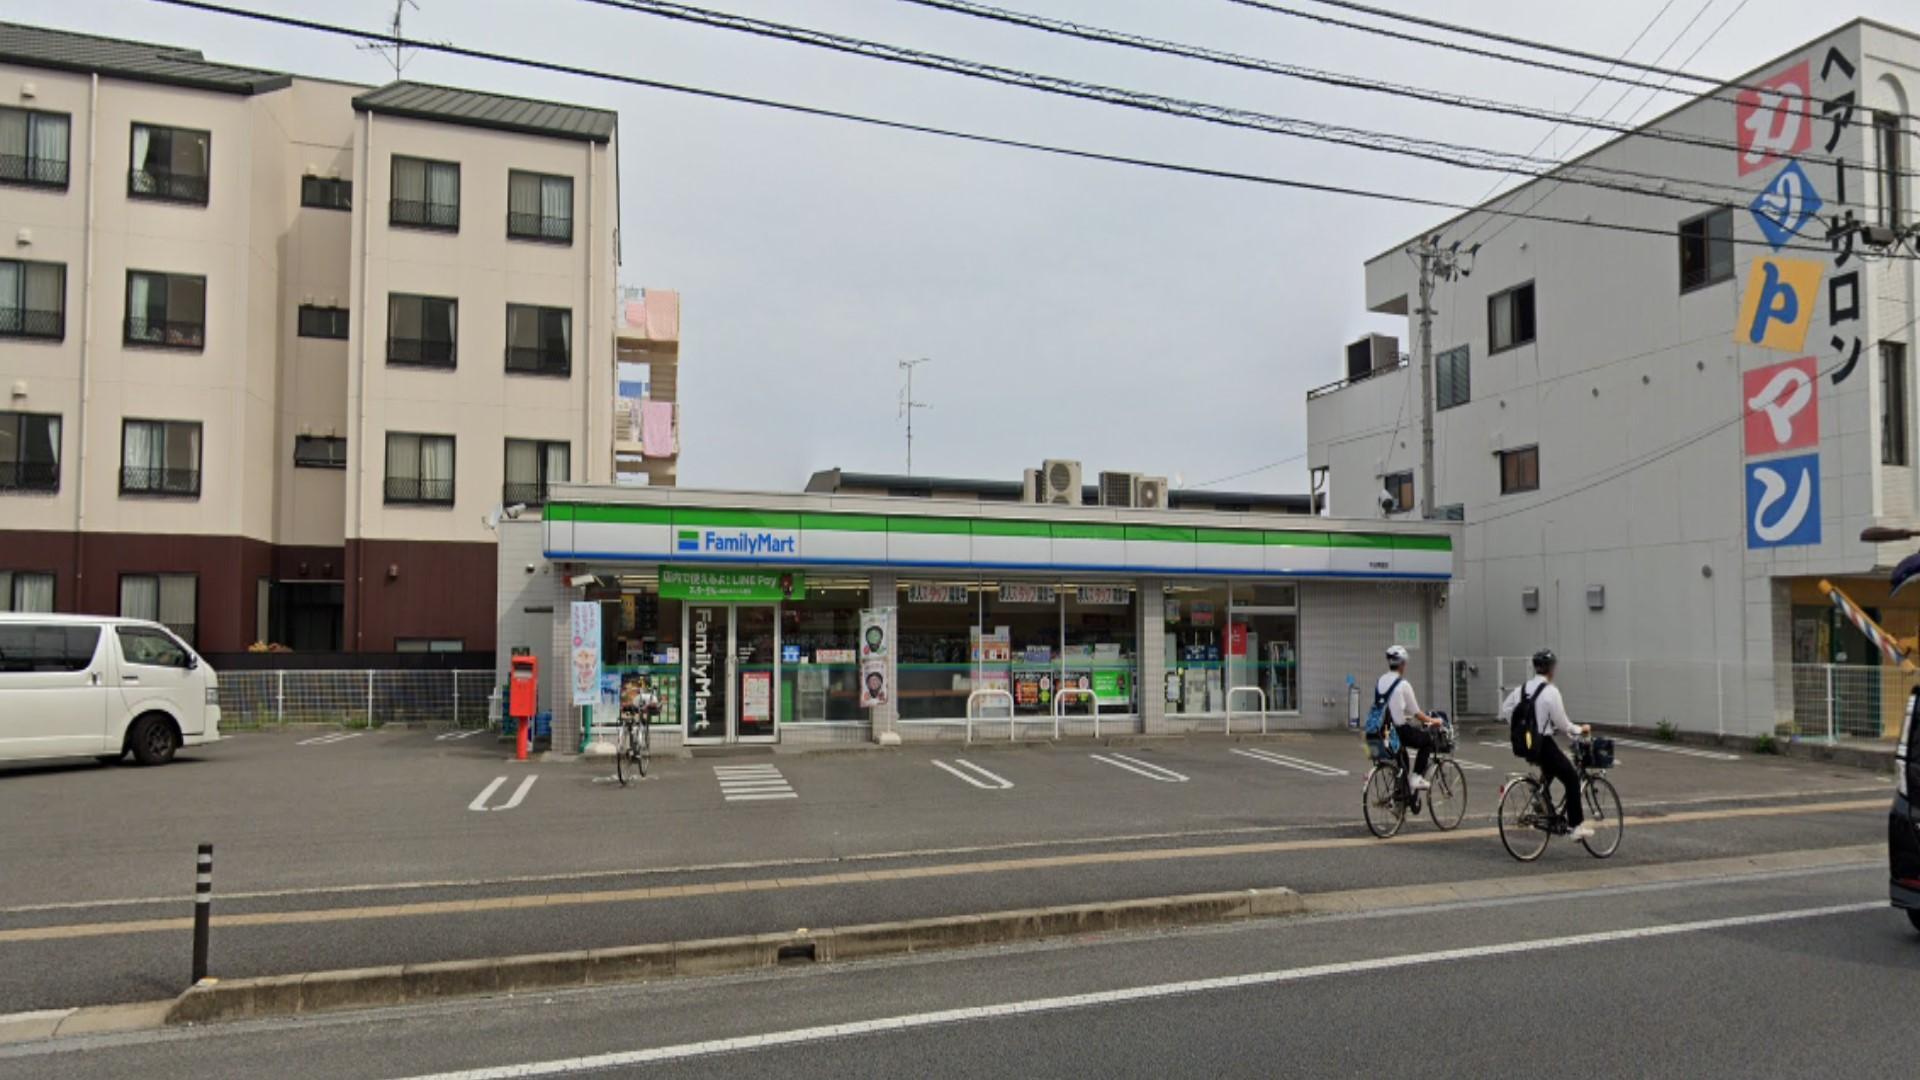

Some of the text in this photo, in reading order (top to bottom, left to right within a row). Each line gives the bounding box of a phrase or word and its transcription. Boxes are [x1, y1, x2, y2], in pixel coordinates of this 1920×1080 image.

[1821, 45, 1862, 384] ヘアーサロン
[706, 531, 794, 553] FamilyMart
[733, 576, 756, 585] LINE
[759, 575, 777, 588] Pay
[693, 609, 712, 730] FamilyMart
